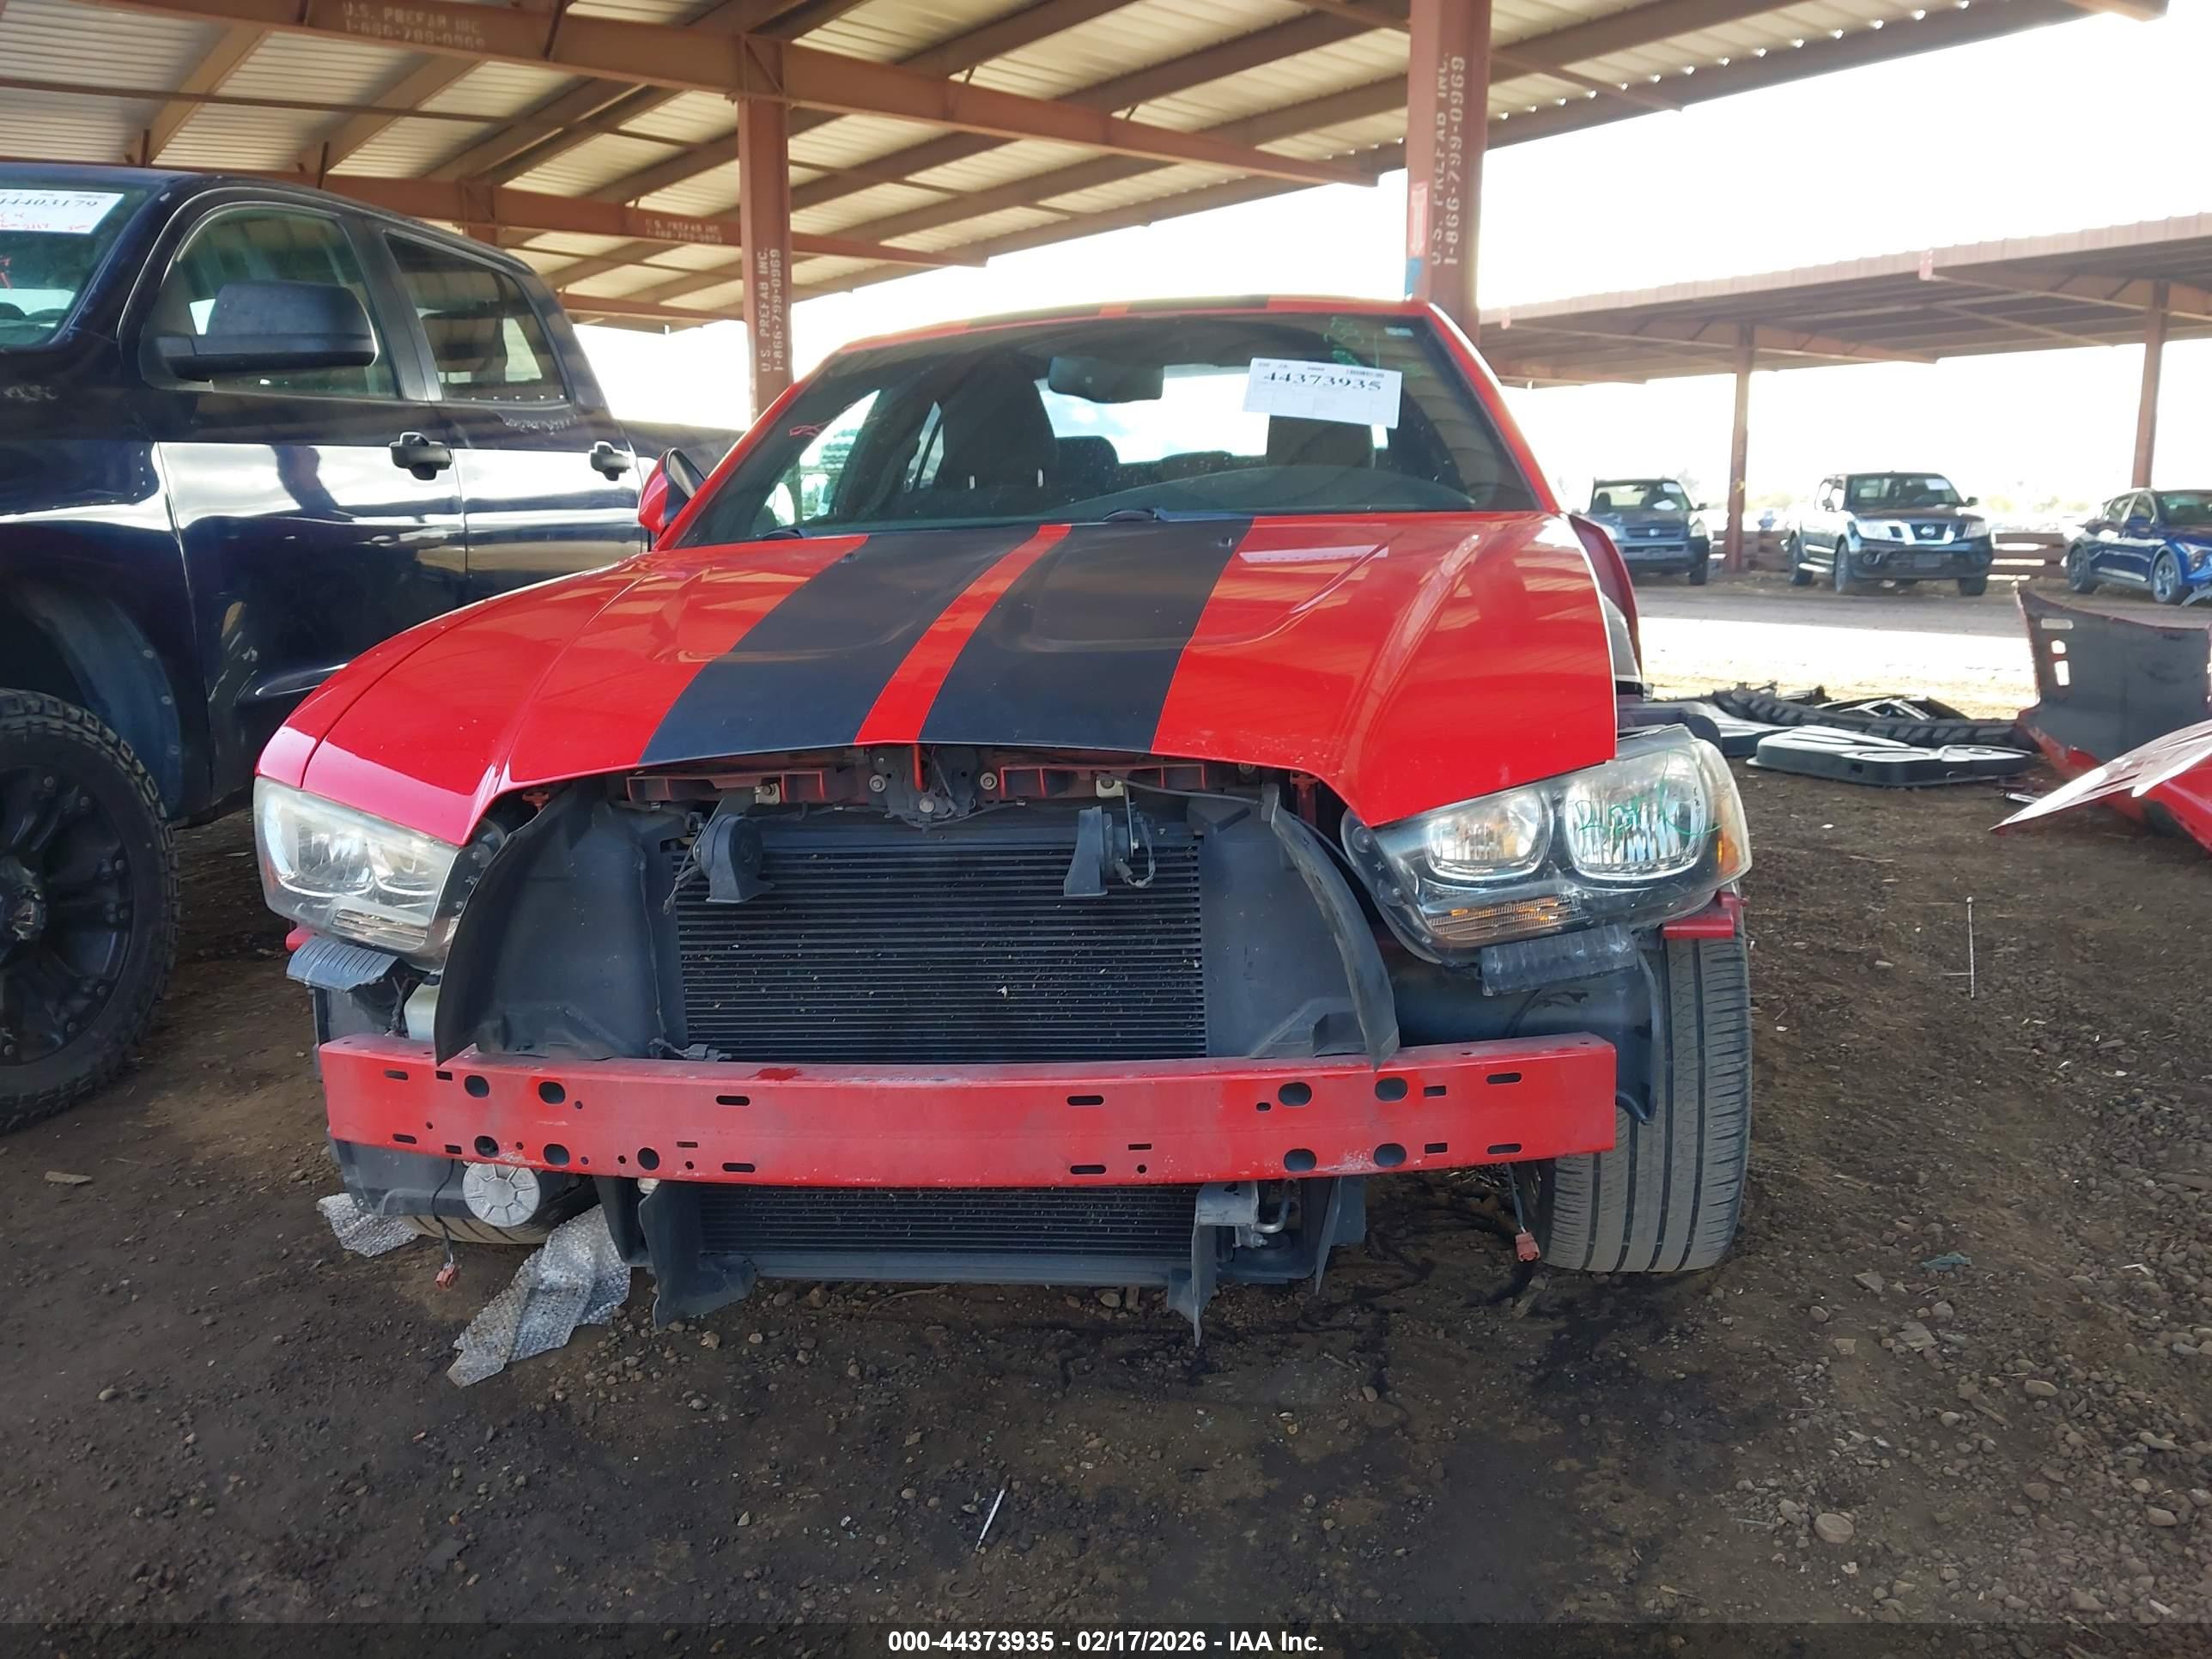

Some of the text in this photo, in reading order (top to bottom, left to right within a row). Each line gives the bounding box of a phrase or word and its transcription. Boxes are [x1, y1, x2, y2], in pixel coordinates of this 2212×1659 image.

[1444, 56, 1465, 265] 1-866-799-0969
[757, 247, 769, 275] INC.
[758, 282, 770, 337] PREFAB
[769, 248, 783, 371] 1-866-799-0969
[1264, 371, 1382, 392] 44373935
